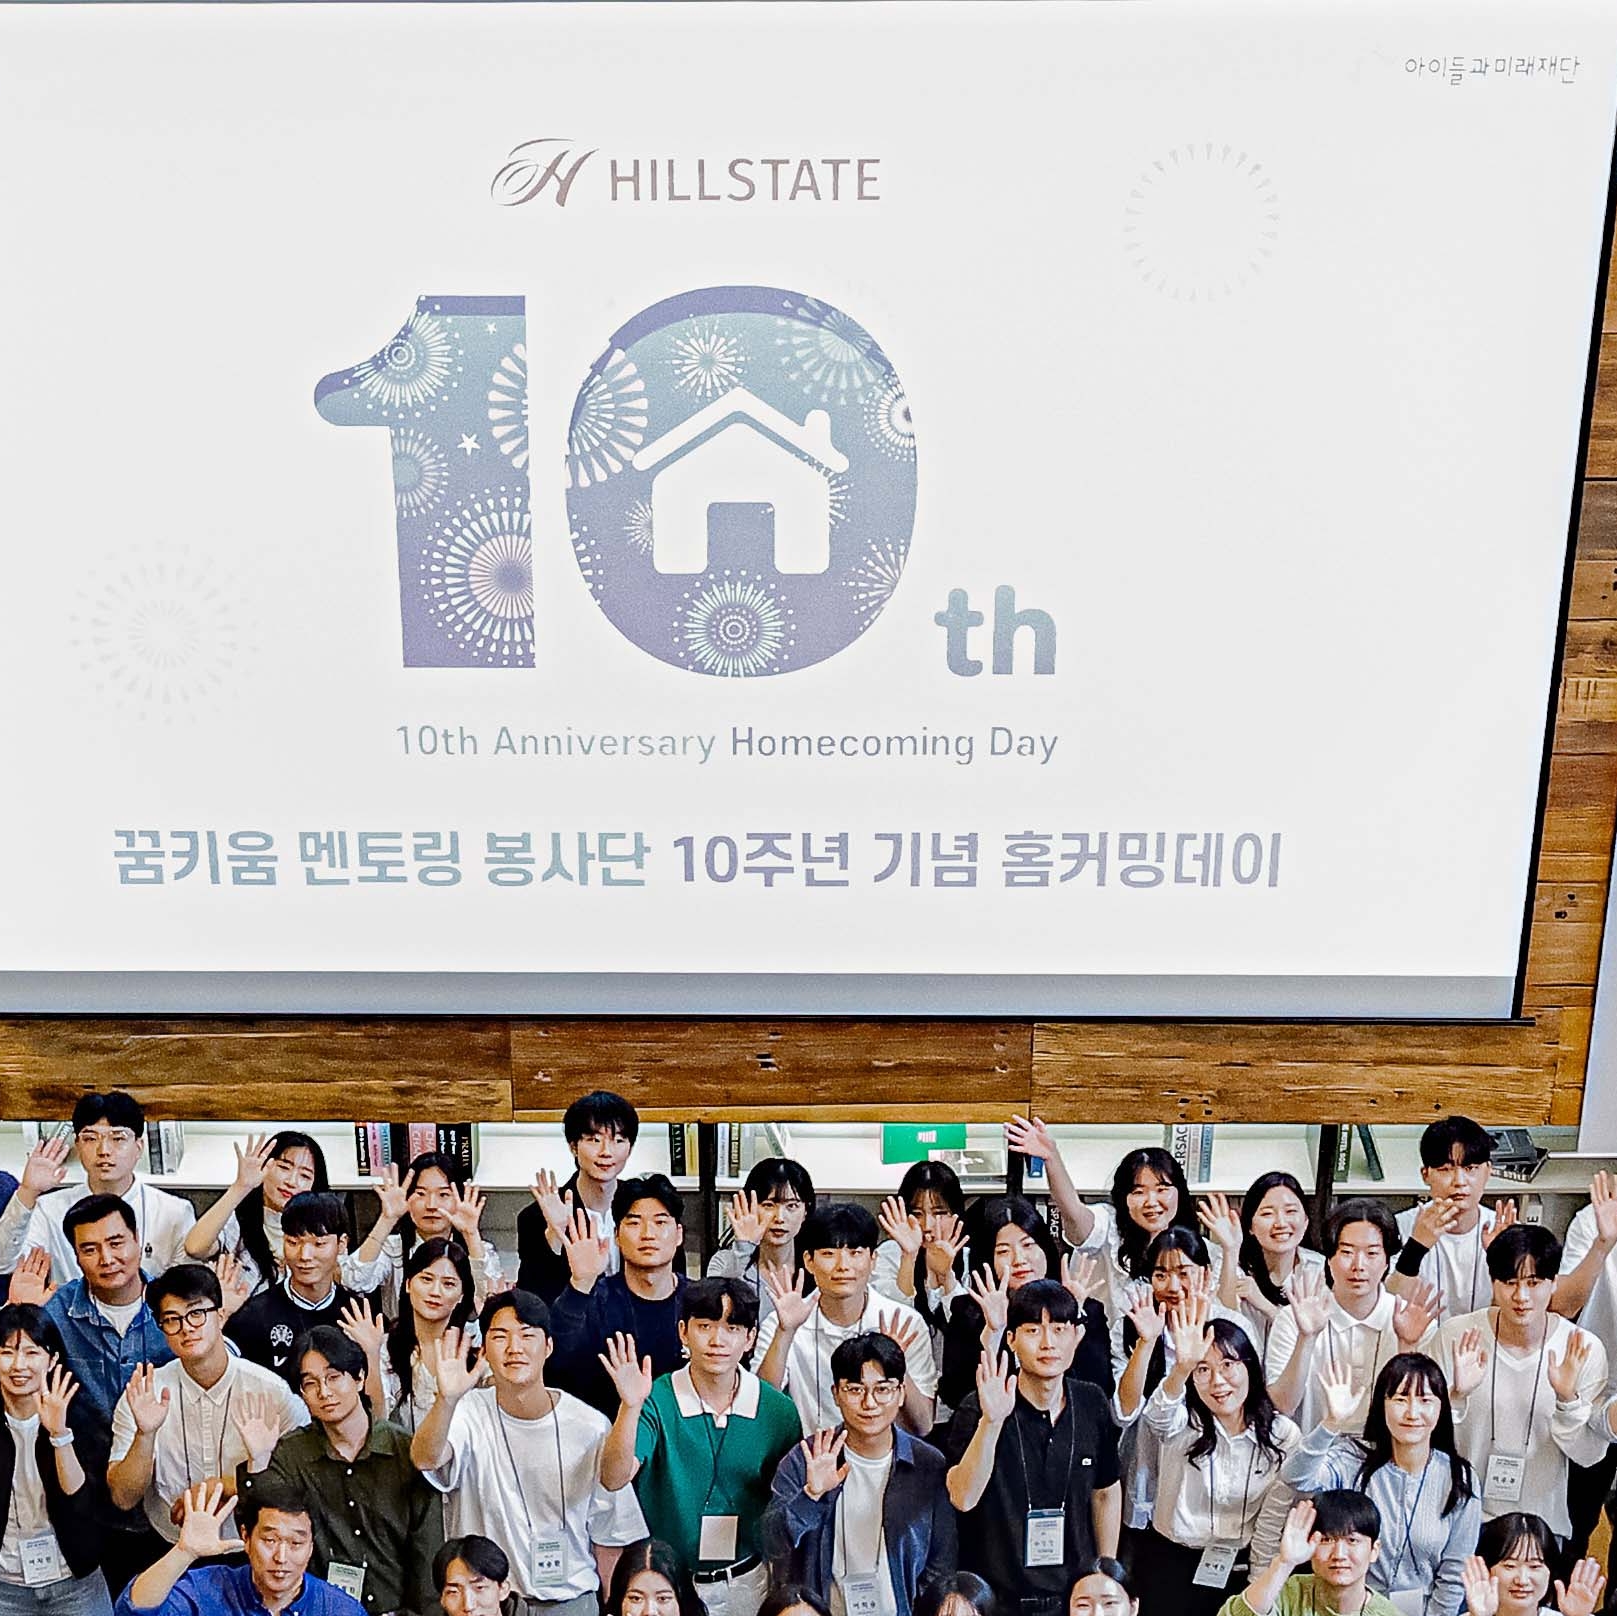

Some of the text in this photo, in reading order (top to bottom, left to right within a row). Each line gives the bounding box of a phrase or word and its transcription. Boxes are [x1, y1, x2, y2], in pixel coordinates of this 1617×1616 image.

[1404, 52, 1581, 87] 아이들과미래재단
[607, 155, 882, 204] HILLSTATE
[395, 724, 1060, 766] 10th Anniversary Homecoming Day
[112, 827, 1284, 890] 꿈키움 멘토링 봉사단 10주년 기념 홈커밍데이
